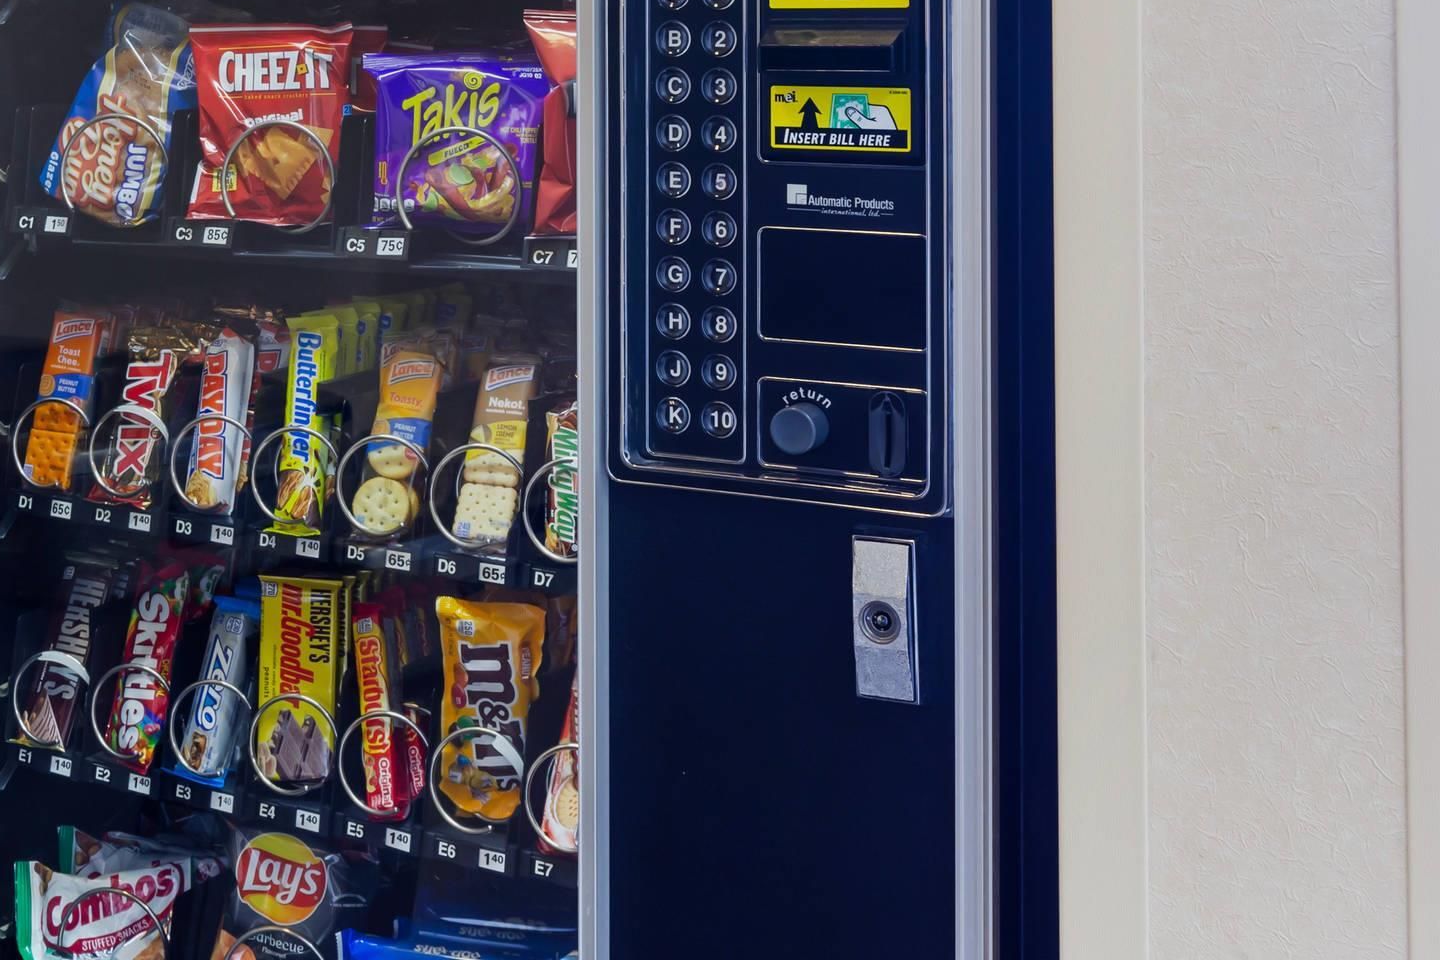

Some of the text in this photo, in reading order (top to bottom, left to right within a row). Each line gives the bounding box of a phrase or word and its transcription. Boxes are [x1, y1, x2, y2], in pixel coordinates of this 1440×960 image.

[668, 30, 682, 47] B
[715, 30, 726, 47] 2
[668, 77, 682, 94] C
[715, 77, 726, 95] 3
[774, 91, 796, 103] mei
[401, 82, 501, 159] Takis
[669, 125, 682, 142] D
[714, 126, 727, 143] 4
[783, 128, 891, 147] INSERT BILL HERE
[115, 143, 148, 220] JUMBO
[669, 171, 681, 189] E
[715, 173, 726, 190] 5
[808, 194, 895, 210] Automatic Products
[19, 216, 34, 229] C1
[670, 218, 681, 236] F
[715, 220, 726, 237] 6
[176, 227, 193, 241] C3
[346, 238, 366, 252] C5
[532, 250, 554, 264] C7
[668, 265, 683, 282] G
[715, 268, 727, 285] 7
[669, 312, 682, 330] H
[715, 316, 727, 333] 8
[58, 344, 81, 356] Toast
[391, 361, 433, 378] Lance
[488, 366, 533, 383] Lance
[669, 360, 681, 378] J
[715, 363, 727, 381] 9
[57, 386, 77, 395] BUTTER
[58, 378, 79, 387] PEANUT
[289, 330, 322, 463] Butterfinger
[781, 386, 832, 410] return
[113, 349, 174, 477] TWIX
[196, 350, 228, 480] PAYDAY
[669, 406, 682, 424] K
[711, 411, 732, 428] 10
[496, 423, 518, 431] LEMON
[19, 495, 71, 515] D1 65¢
[95, 508, 111, 523] D2
[176, 519, 192, 535] D3
[260, 533, 277, 548] D4
[347, 544, 365, 561] D5
[437, 558, 456, 574] D6
[534, 571, 554, 588] D7
[308, 589, 331, 664] HERSHEY'S
[464, 620, 473, 636] 250
[44, 577, 107, 701] HERSHY'S
[117, 590, 171, 750] Skittles
[521, 646, 532, 681] PEANUT
[359, 638, 389, 753] Starburst
[19, 749, 33, 763] E1
[95, 767, 110, 782] E2
[378, 757, 393, 808] Original
[176, 785, 191, 800] E3
[259, 804, 276, 819] E4
[346, 822, 364, 838] E5
[438, 842, 456, 859] E6
[243, 848, 322, 905] Lay's
[534, 860, 554, 877] E7
[45, 862, 176, 938] Combos
[81, 919, 150, 952] STUFFED SNACKS
[248, 932, 305, 955] arbecue
